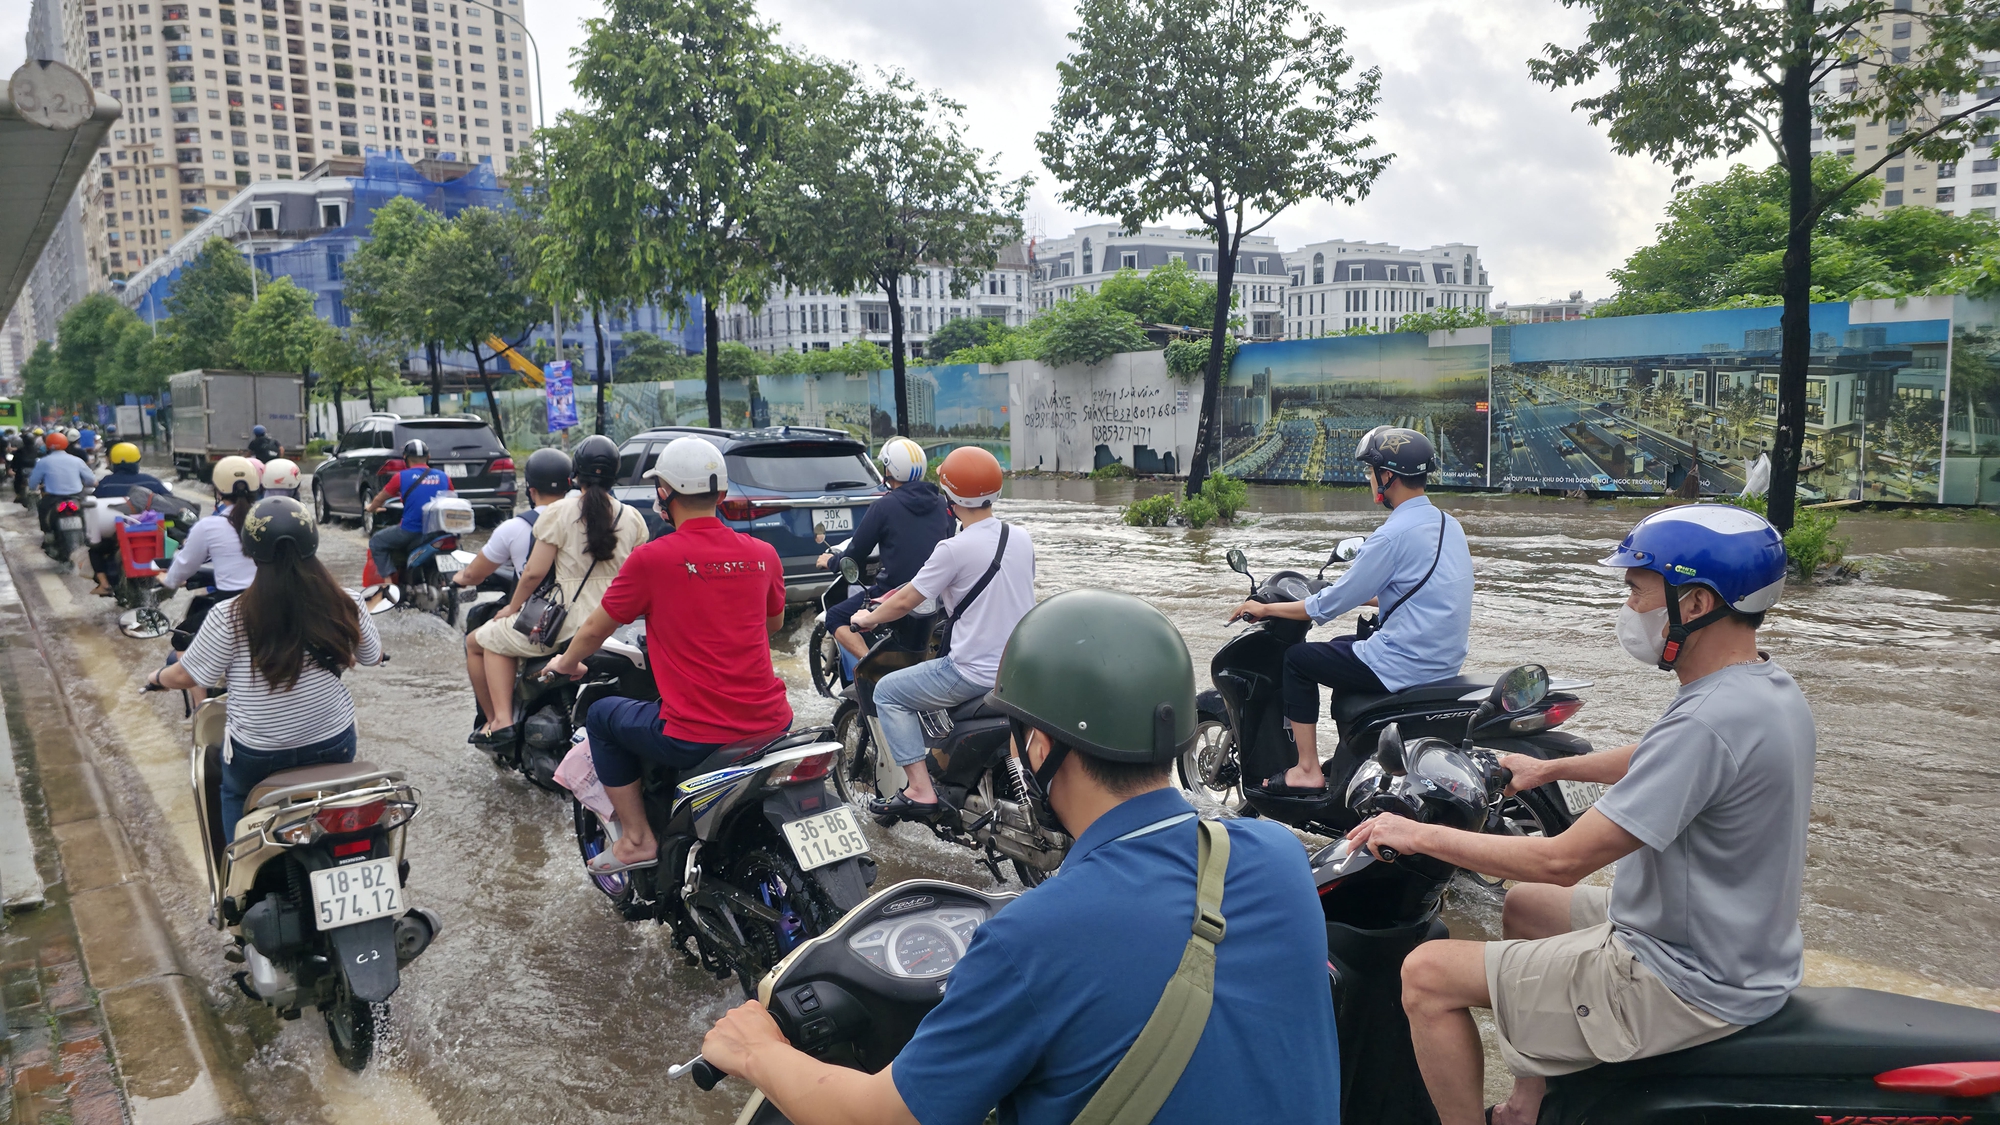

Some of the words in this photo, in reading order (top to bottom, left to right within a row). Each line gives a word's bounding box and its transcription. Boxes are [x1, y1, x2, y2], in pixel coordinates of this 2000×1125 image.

[823, 520, 849, 530] 77.40
[824, 509, 841, 519] 30K
[1566, 784, 1599, 811] 386.97
[795, 812, 848, 841] 36-B6
[339, 855, 366, 865] HONDA
[801, 831, 864, 865] 114.95
[326, 864, 386, 896] 18-B2
[320, 888, 397, 924] 574.12
